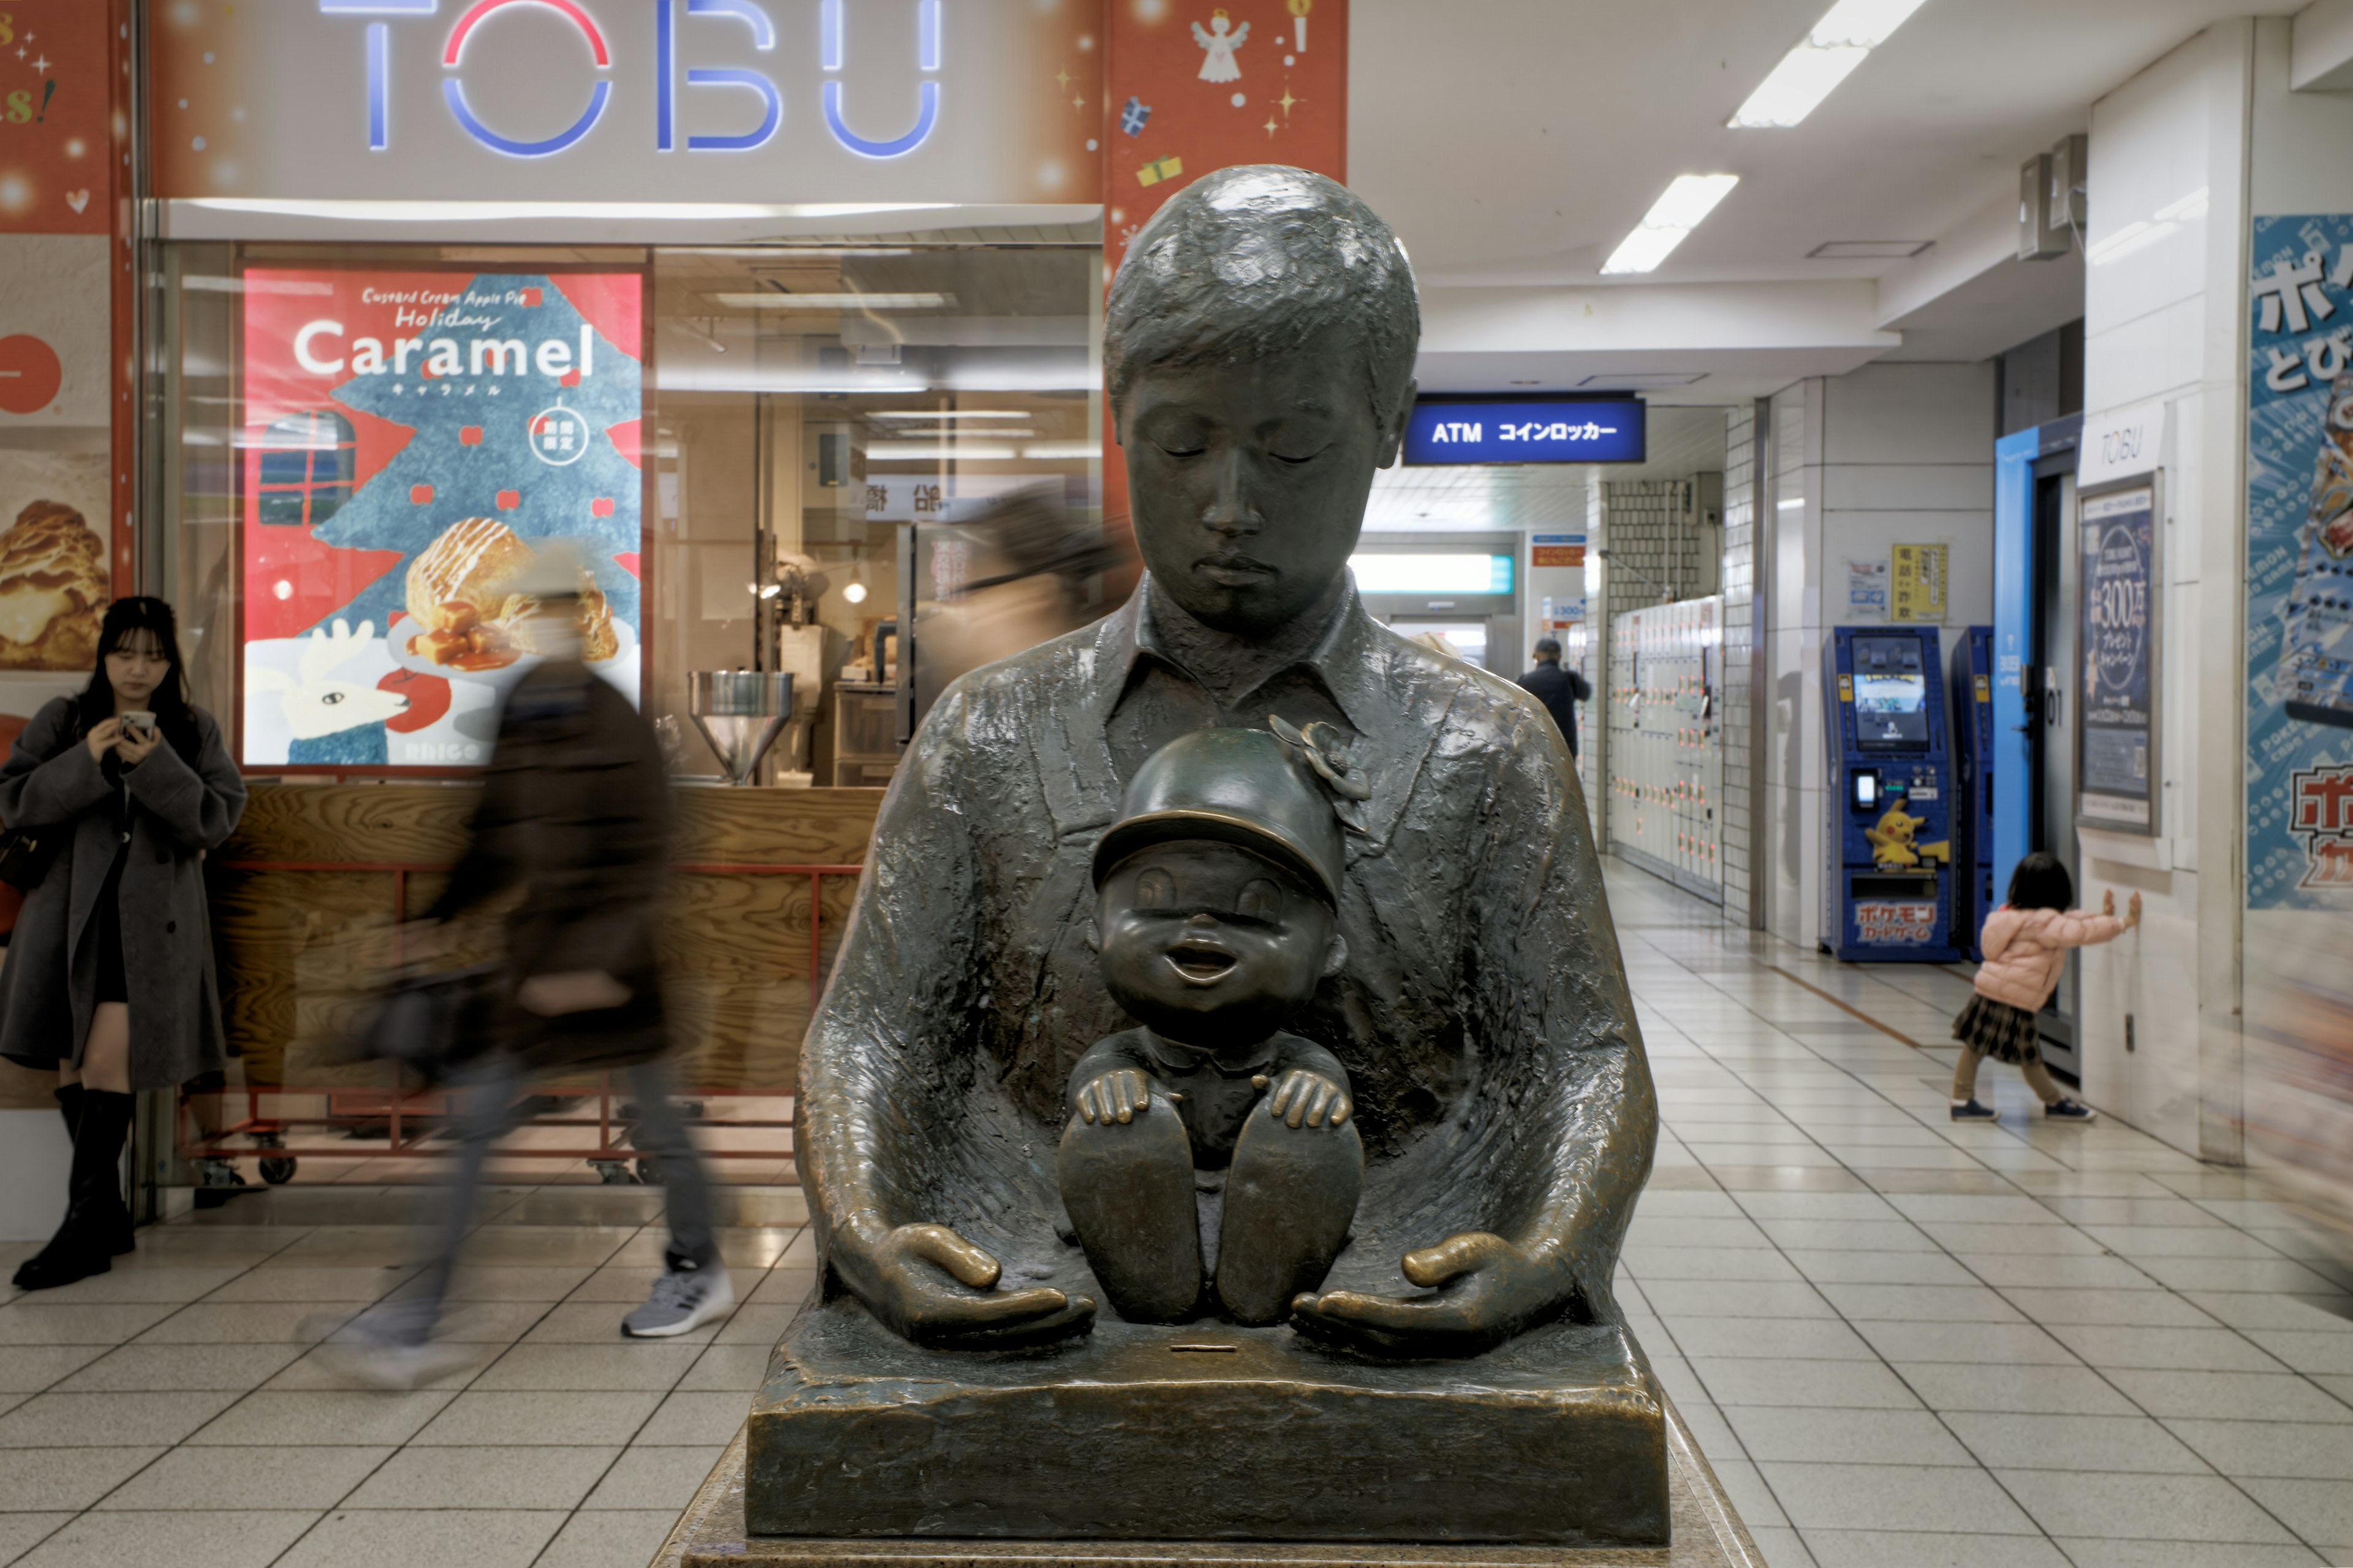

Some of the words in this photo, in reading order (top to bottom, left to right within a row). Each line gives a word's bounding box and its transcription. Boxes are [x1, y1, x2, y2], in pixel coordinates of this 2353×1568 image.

[320, 0, 939, 159] TOBU
[362, 288, 417, 304] Custard
[420, 289, 461, 305] Cream
[465, 291, 501, 306] Apple
[505, 290, 526, 305] Pie
[395, 306, 502, 331] Holiday
[294, 319, 593, 376] Caramel
[392, 383, 501, 395] キャラメル
[1432, 422, 1482, 443] ATM
[1499, 422, 1617, 442] コインロッカー
[2102, 425, 2143, 464] TOBU
[1859, 903, 1935, 923] ポケモン
[1863, 925, 1929, 939] カードゲーム
